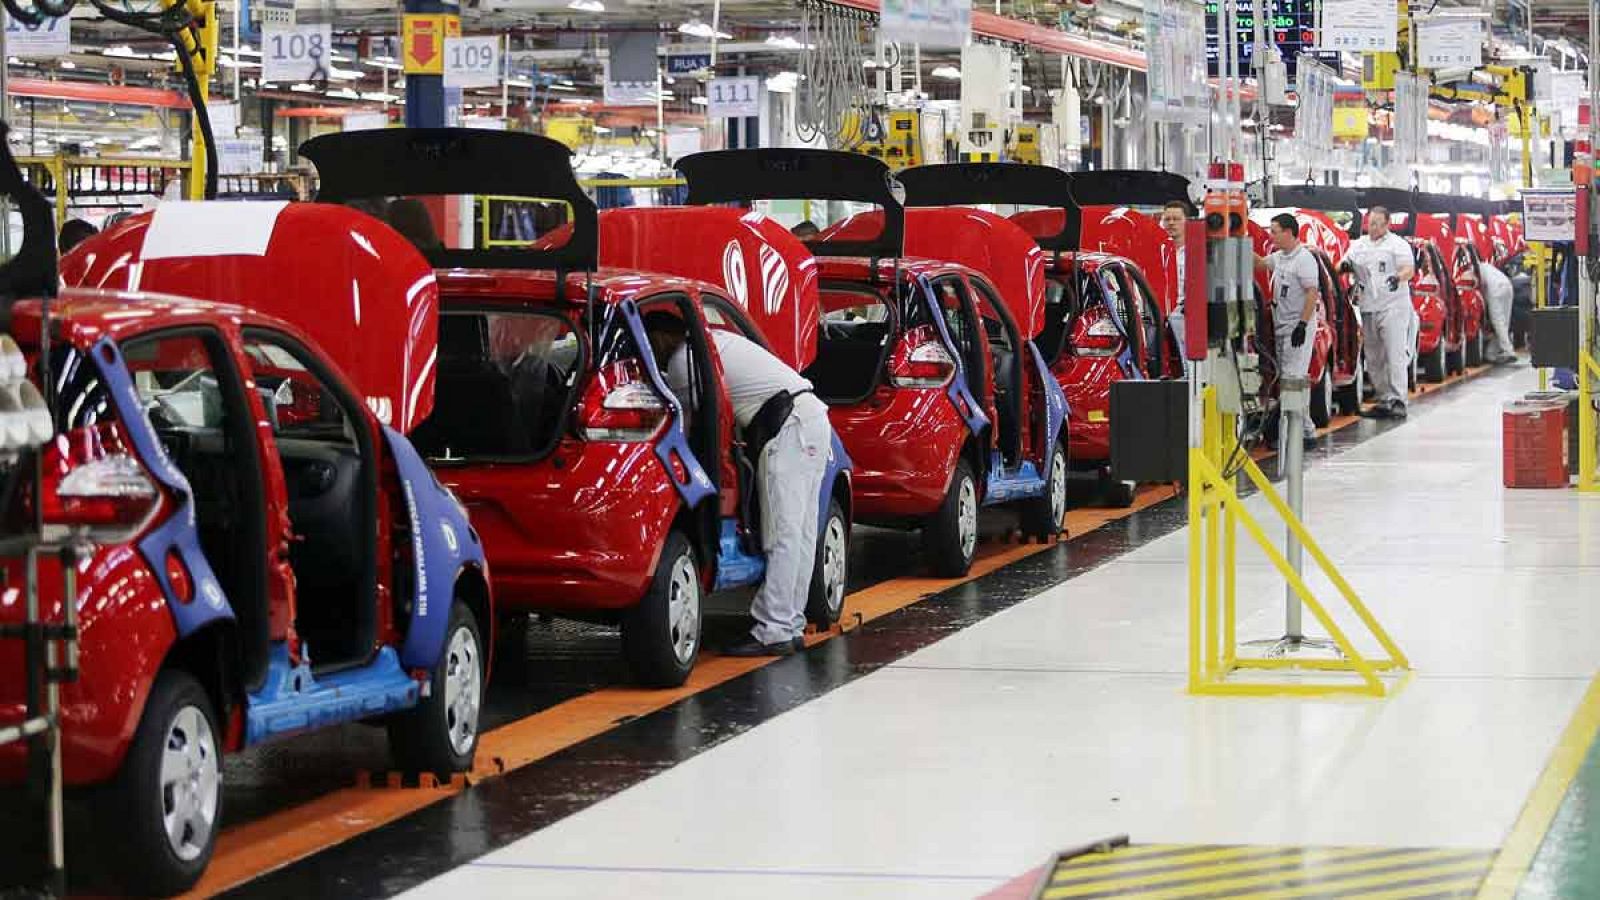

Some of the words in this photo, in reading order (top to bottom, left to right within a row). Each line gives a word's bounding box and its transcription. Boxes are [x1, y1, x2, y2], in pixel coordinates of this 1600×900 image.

[271, 34, 324, 61] 108
[450, 45, 493, 69] 109
[714, 84, 752, 103] 111
